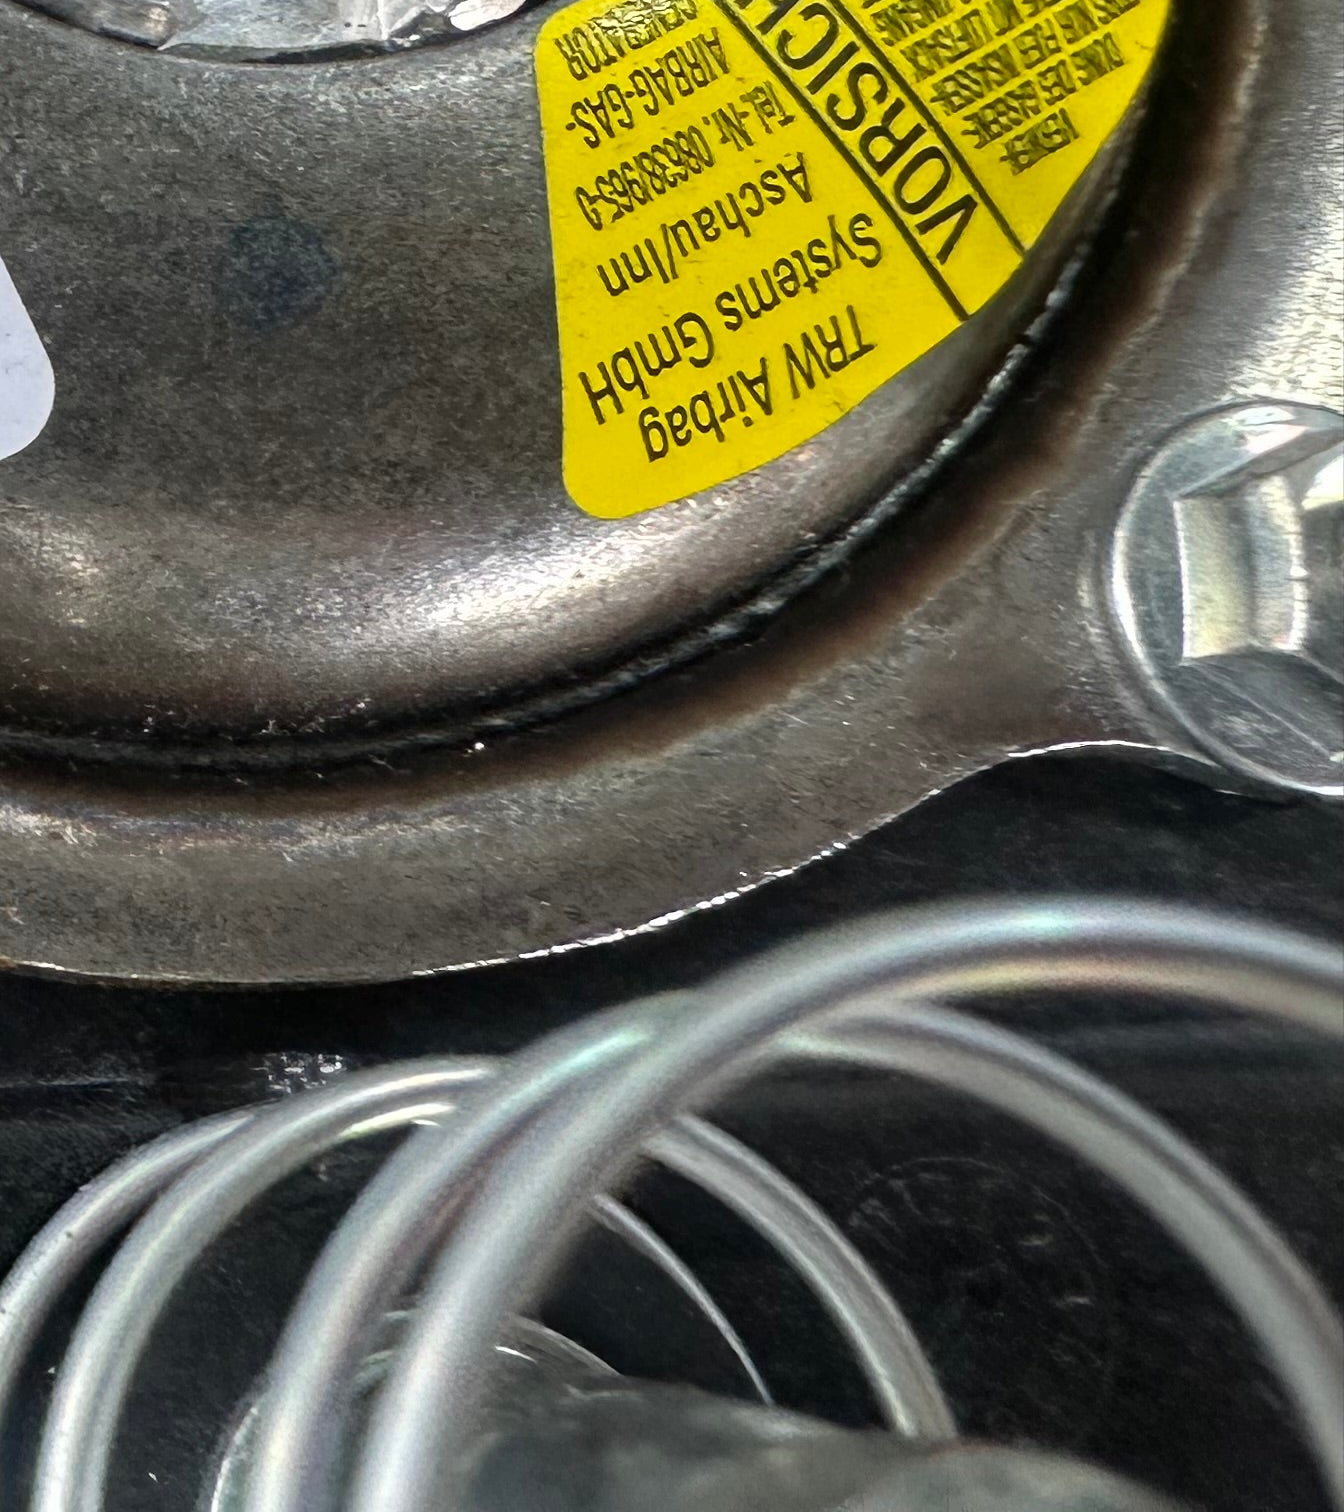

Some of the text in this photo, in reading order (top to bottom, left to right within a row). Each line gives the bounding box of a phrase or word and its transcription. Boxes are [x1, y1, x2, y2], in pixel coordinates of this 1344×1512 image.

[566, 28, 730, 149] AIRBAG-GAS-
[575, 126, 714, 231] 08638/965-0
[597, 152, 812, 296] Aschau/Inn
[579, 213, 882, 425] Systems GmbH
[639, 305, 875, 462] TRW Airbag
